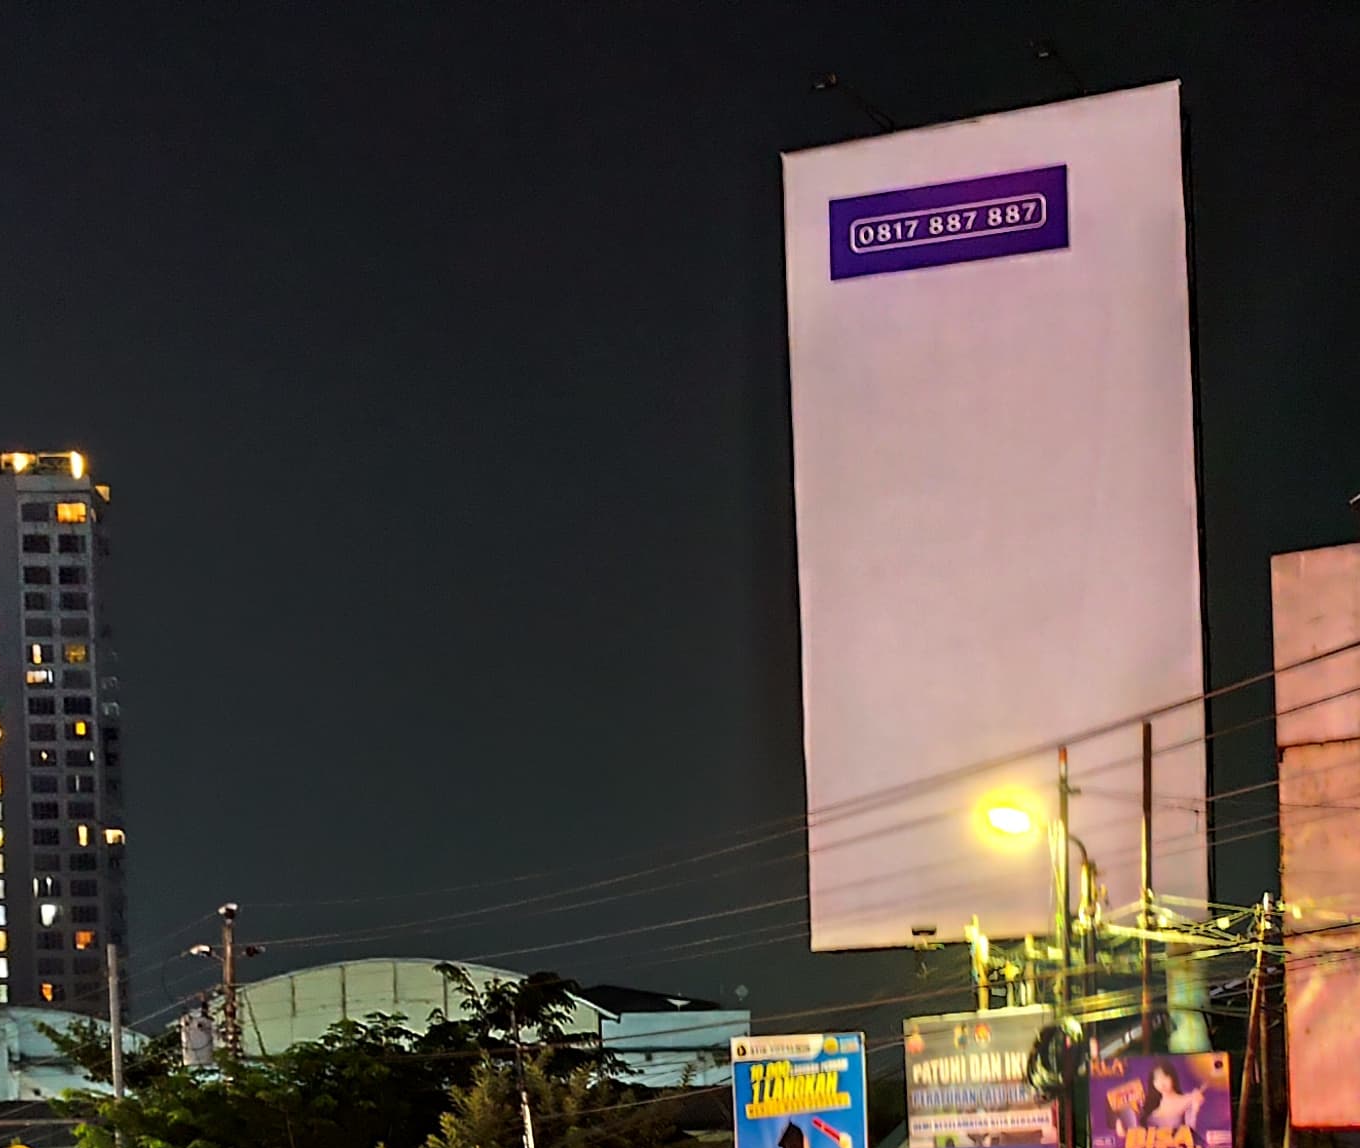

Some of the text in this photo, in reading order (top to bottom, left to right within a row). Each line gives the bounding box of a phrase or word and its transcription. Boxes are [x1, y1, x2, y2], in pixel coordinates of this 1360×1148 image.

[858, 202, 1037, 245] 0817 887 887
[969, 1051, 1002, 1082] DAN
